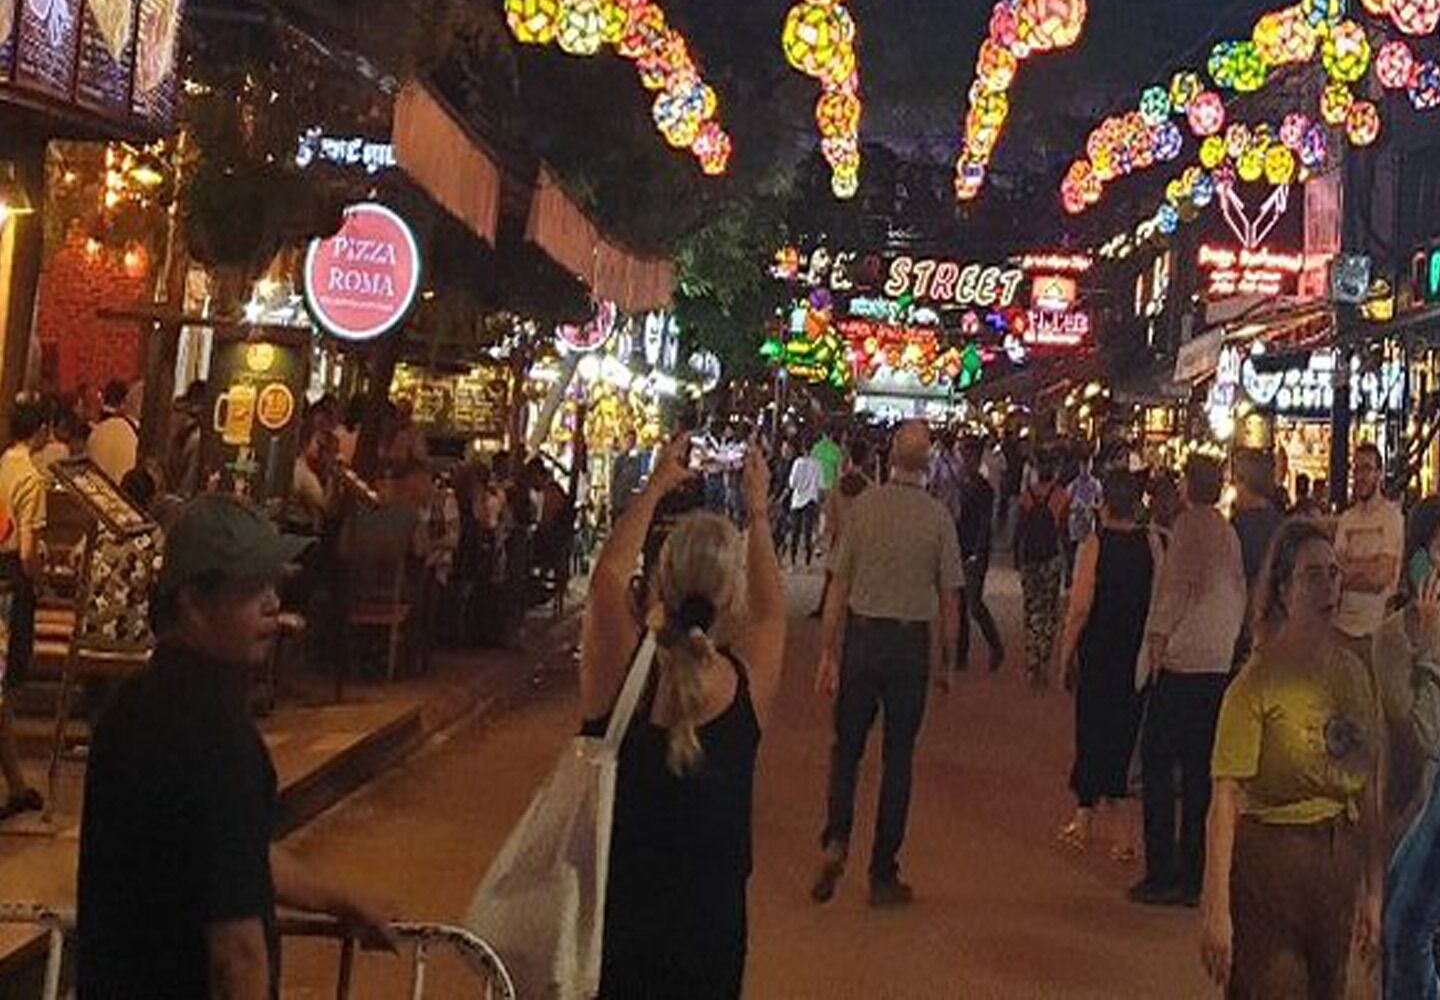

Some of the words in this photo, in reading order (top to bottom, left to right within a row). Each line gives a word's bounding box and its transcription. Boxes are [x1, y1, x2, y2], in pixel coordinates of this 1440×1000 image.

[333, 234, 396, 266] PIZZA
[328, 266, 394, 297] ROMA
[884, 257, 1023, 306] STREET
